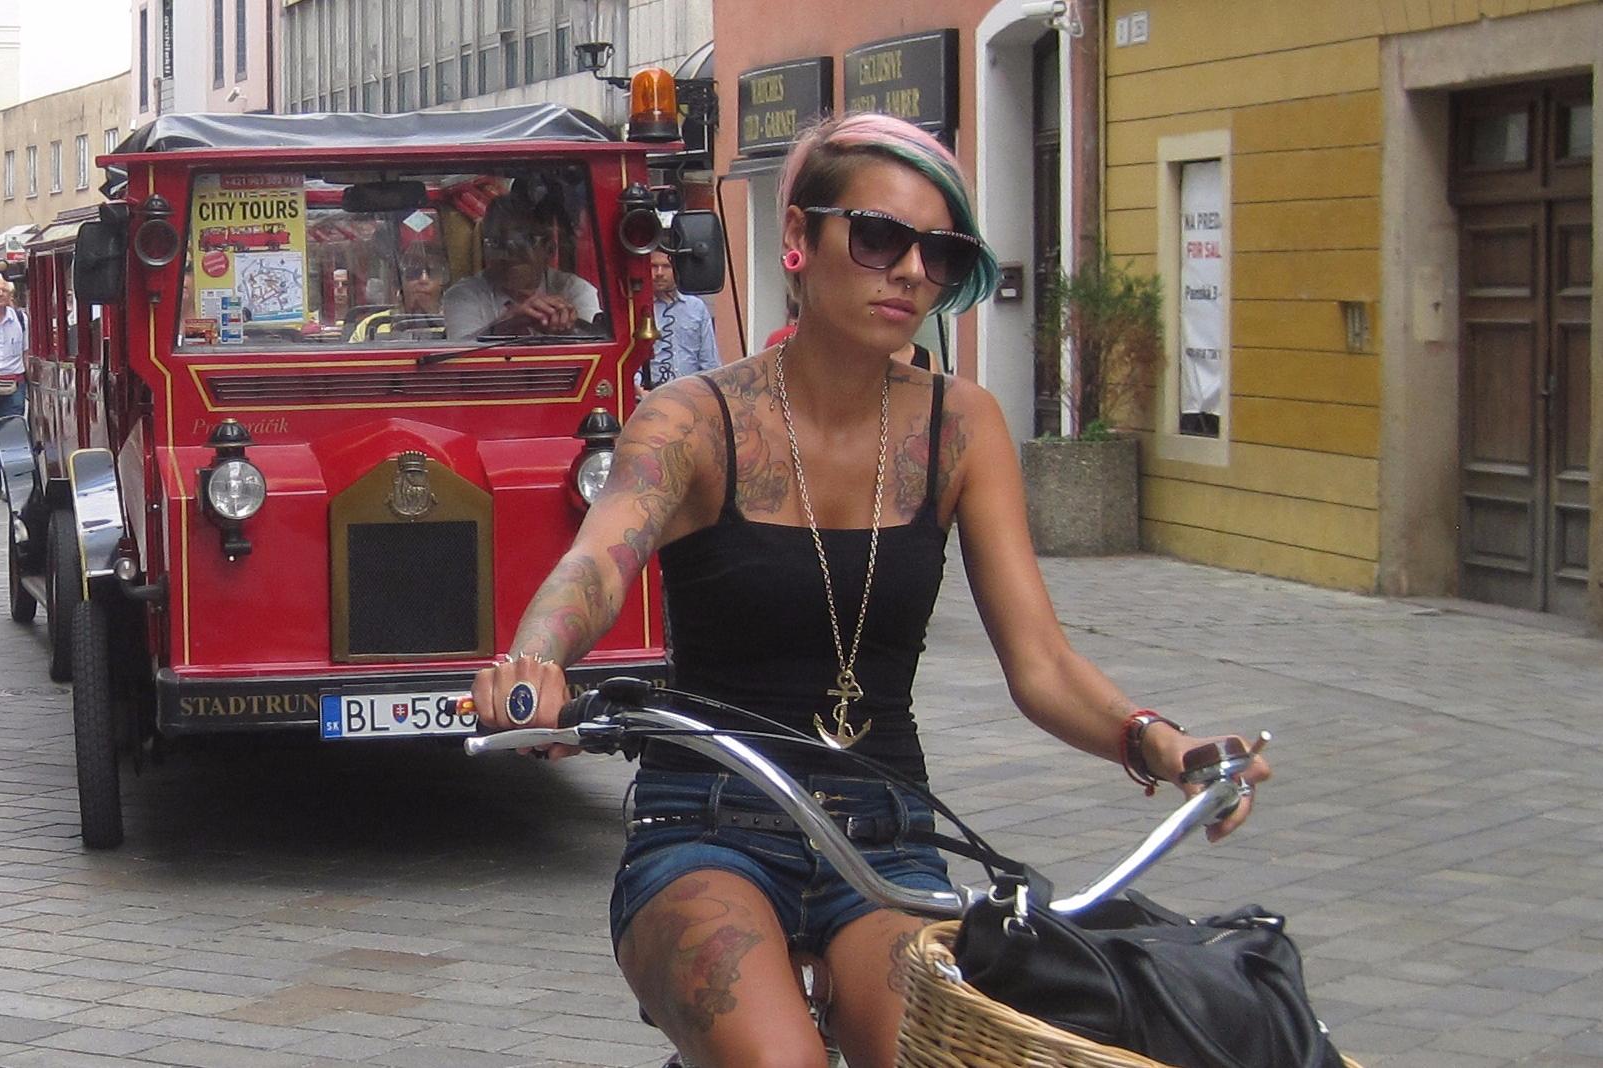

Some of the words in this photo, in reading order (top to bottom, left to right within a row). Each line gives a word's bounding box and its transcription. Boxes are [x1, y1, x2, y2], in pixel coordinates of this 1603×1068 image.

[199, 202, 235, 221] CITY
[239, 199, 299, 220] TOURS
[325, 721, 340, 732] SK
[346, 698, 391, 733] BL
